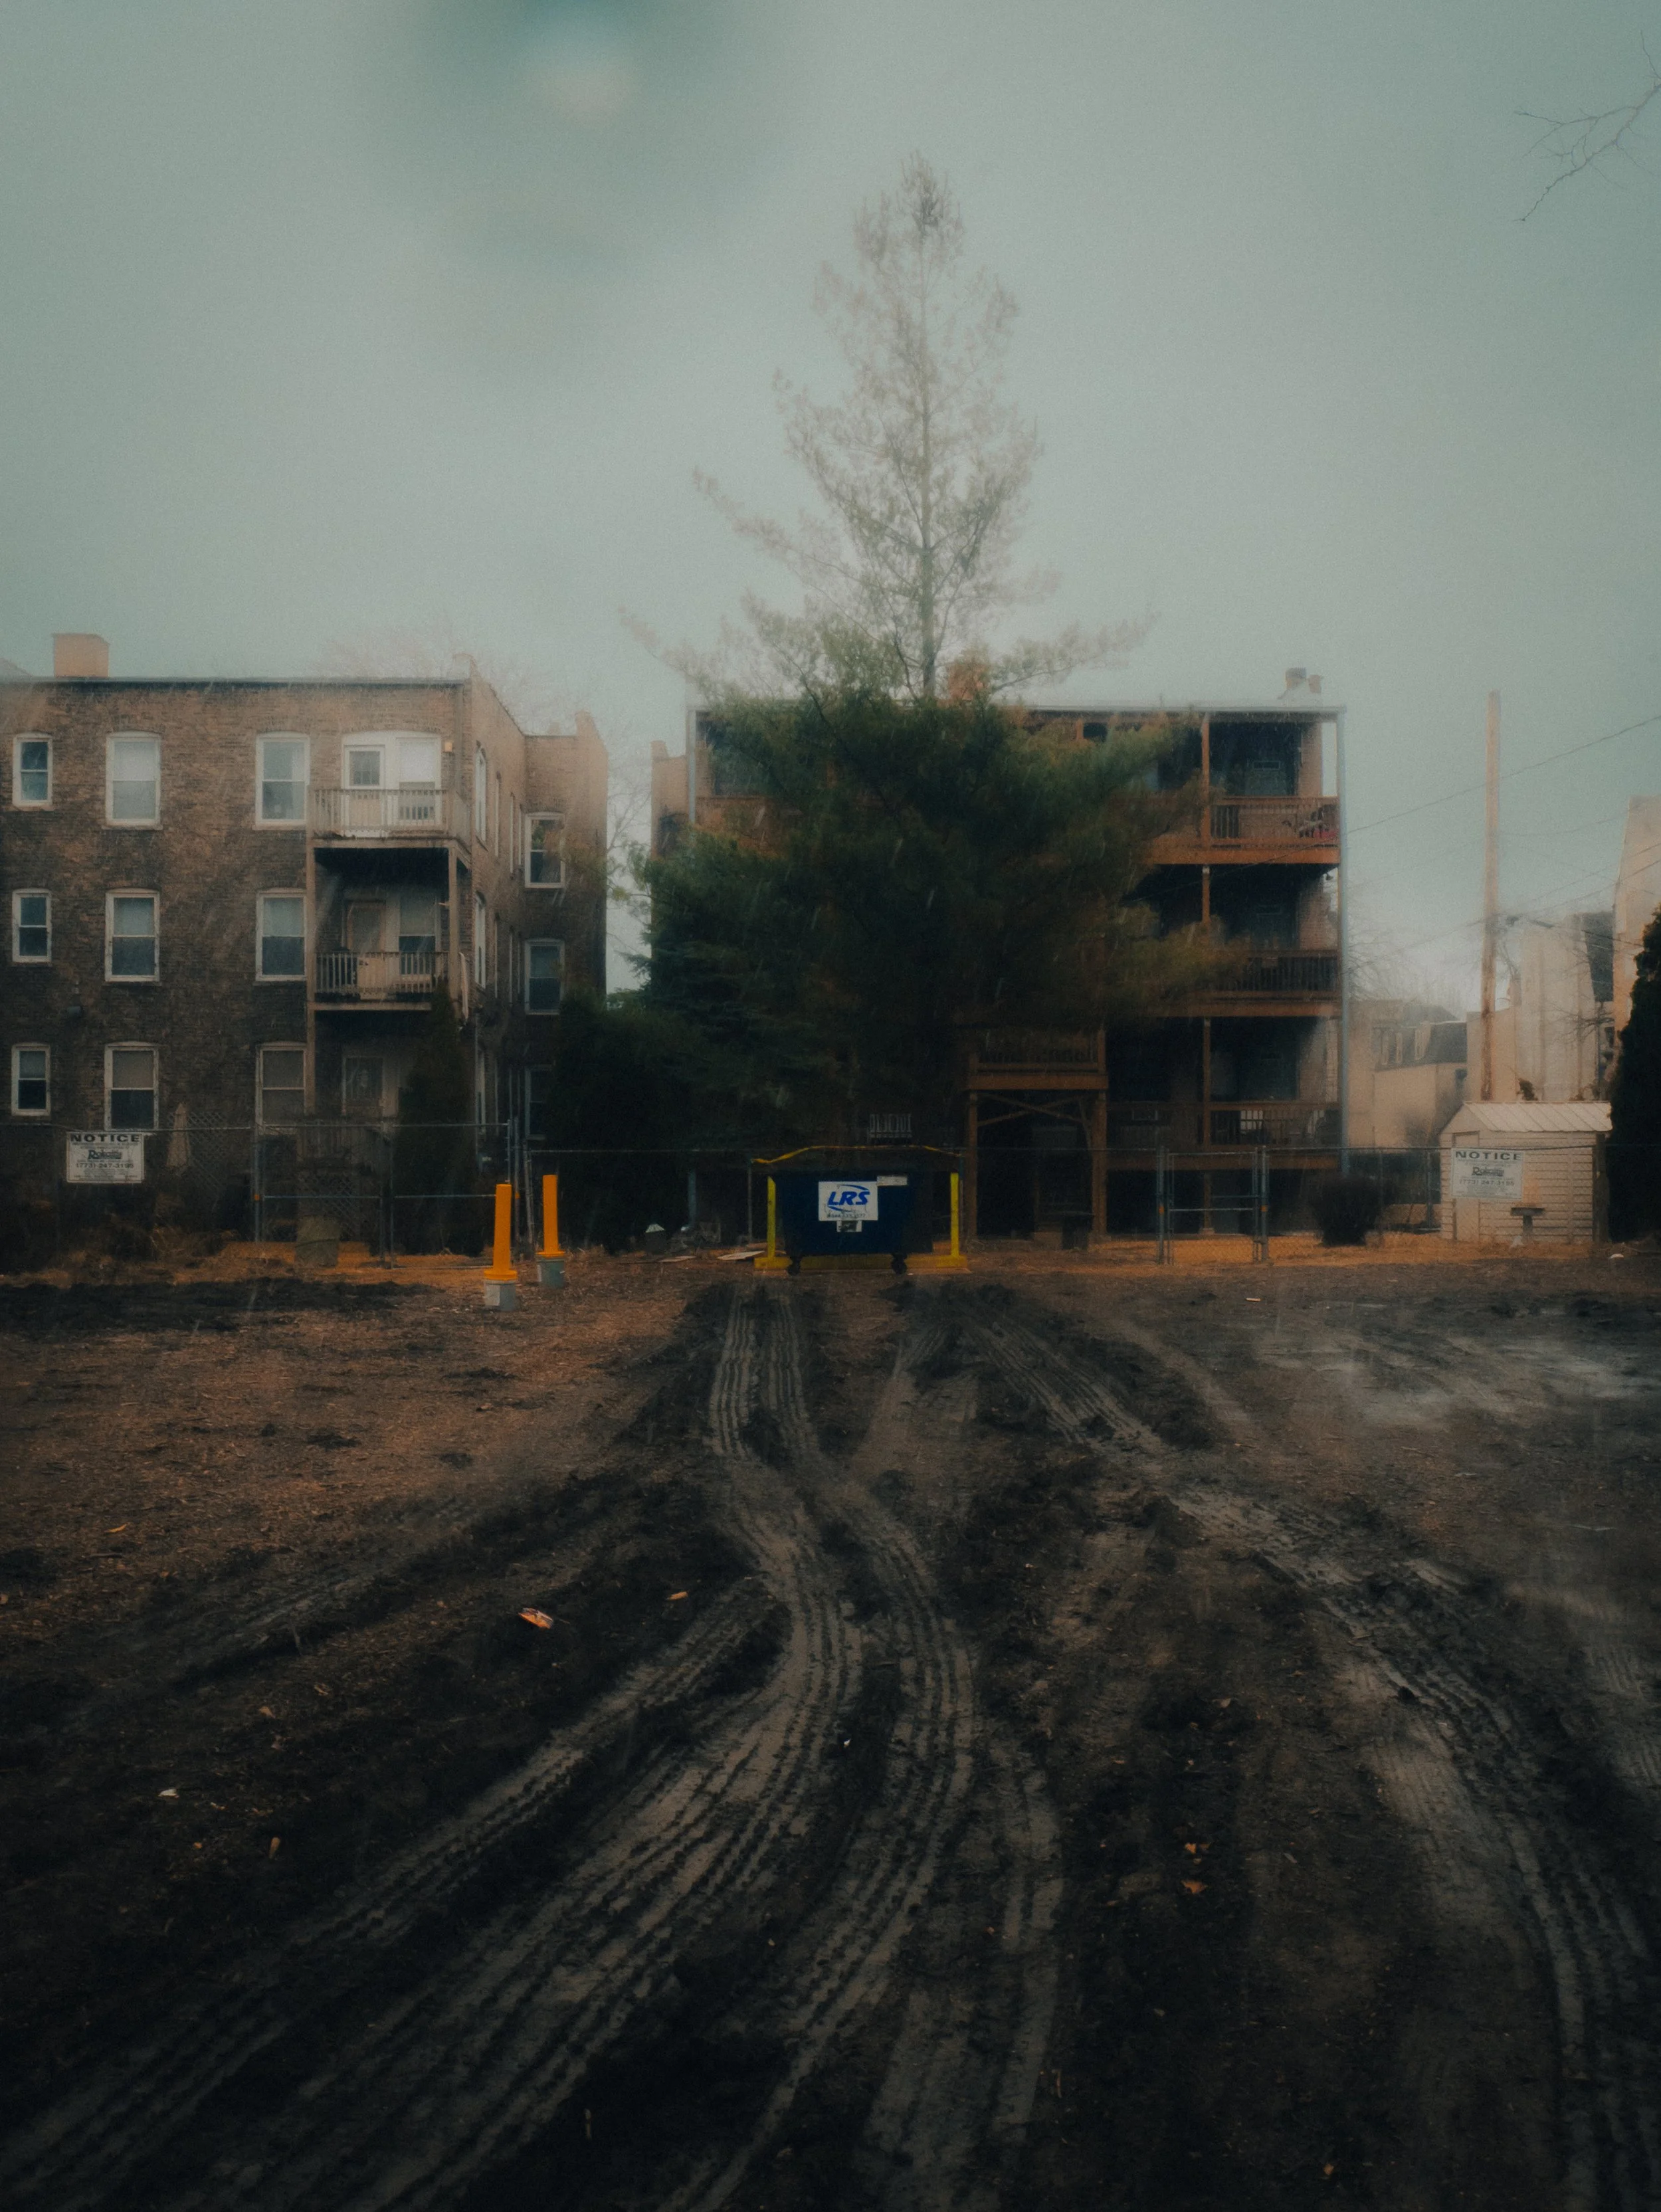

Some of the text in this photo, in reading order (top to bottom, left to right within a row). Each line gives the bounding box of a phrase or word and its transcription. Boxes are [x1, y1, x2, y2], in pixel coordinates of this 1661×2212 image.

[70, 1134, 140, 1142] NOTICE
[1456, 1151, 1521, 1161] NOTICE
[828, 1191, 870, 1205] LRS
